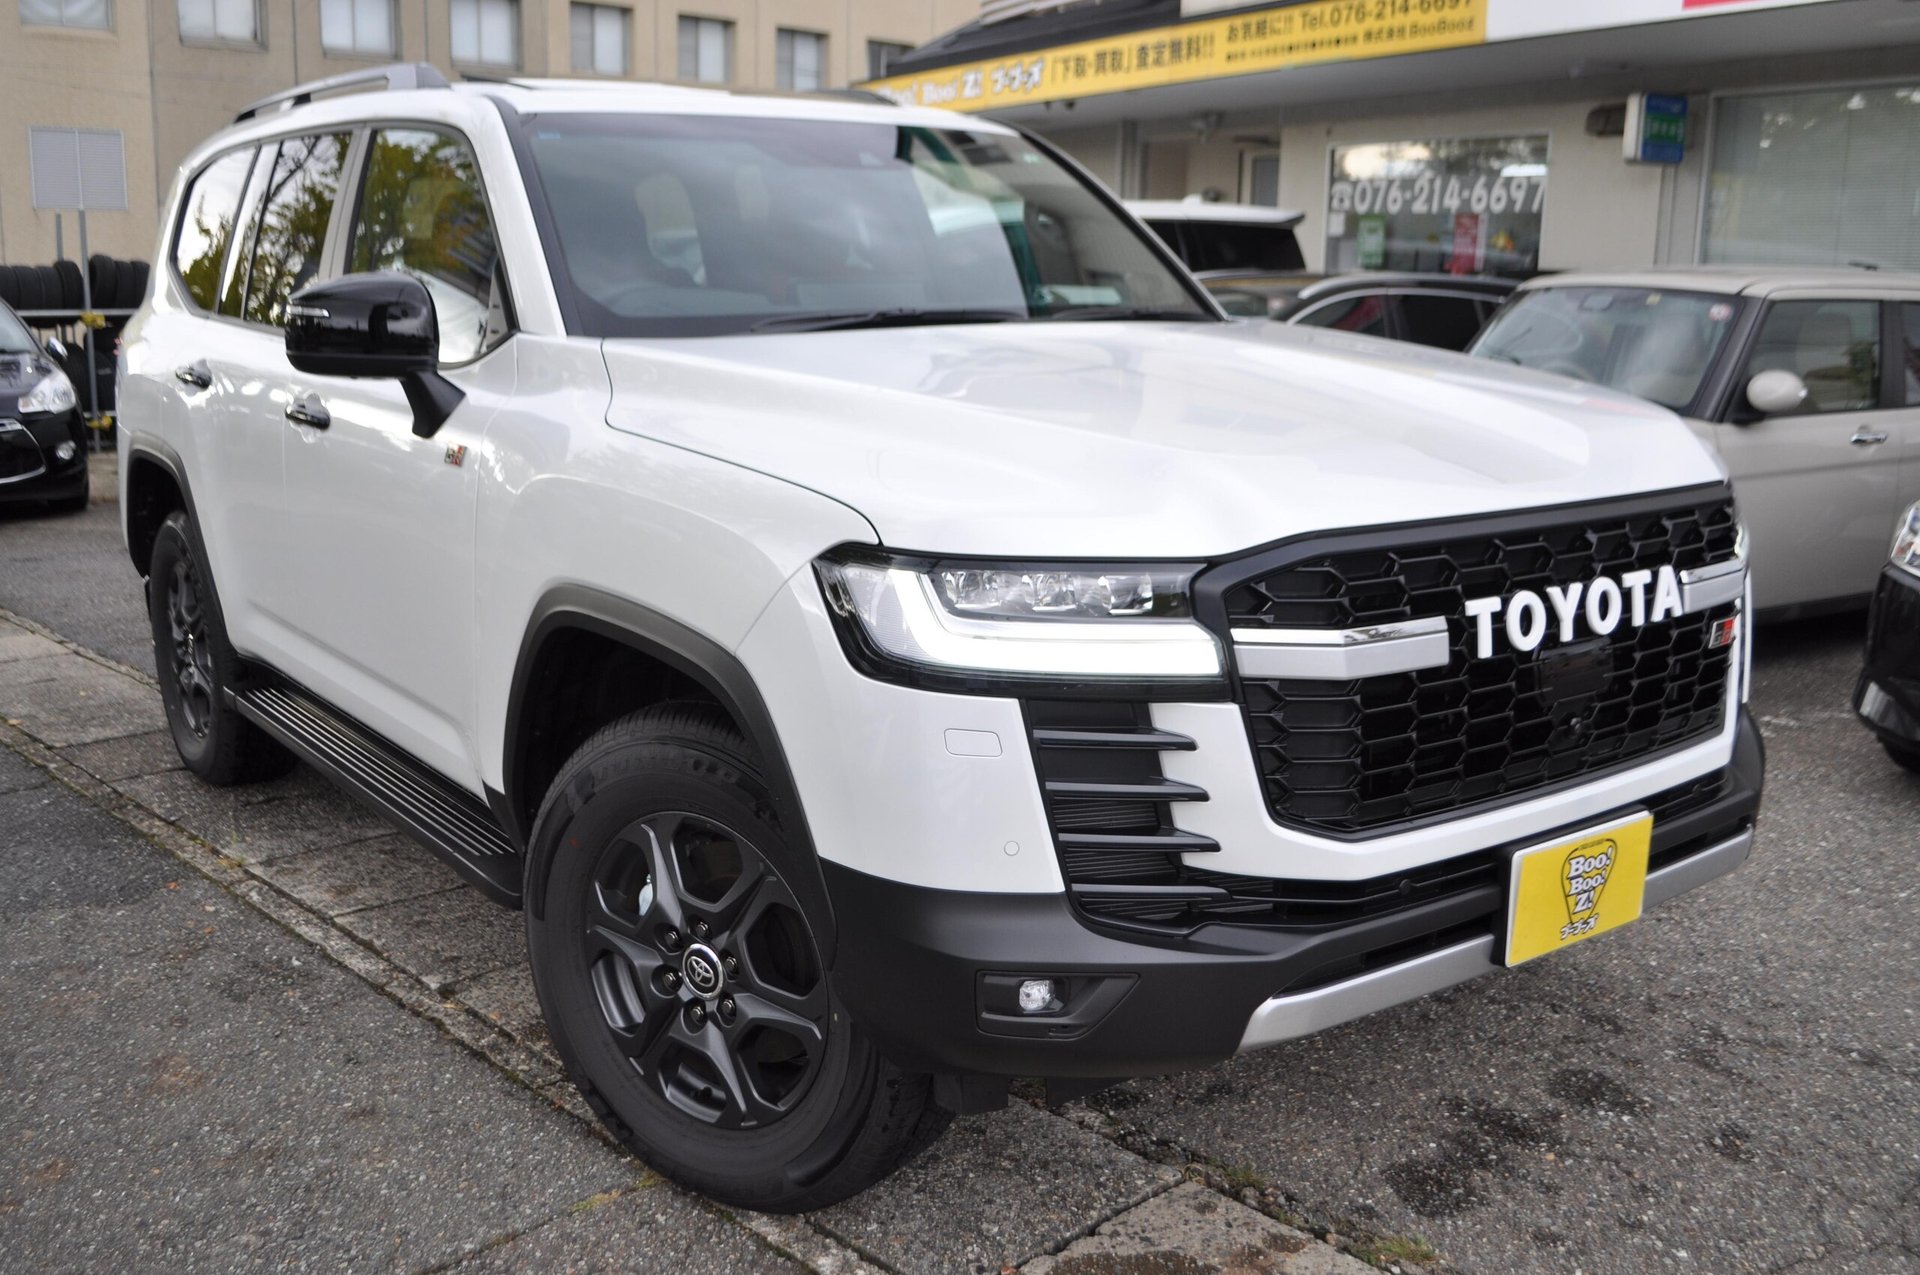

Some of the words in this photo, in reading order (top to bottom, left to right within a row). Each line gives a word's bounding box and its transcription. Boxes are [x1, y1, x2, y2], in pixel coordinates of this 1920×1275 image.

[1464, 564, 1683, 660] TOYOTA
[1567, 845, 1613, 879] Boo!
[1567, 868, 1607, 896] Boo!
[1572, 889, 1595, 915] Z!
